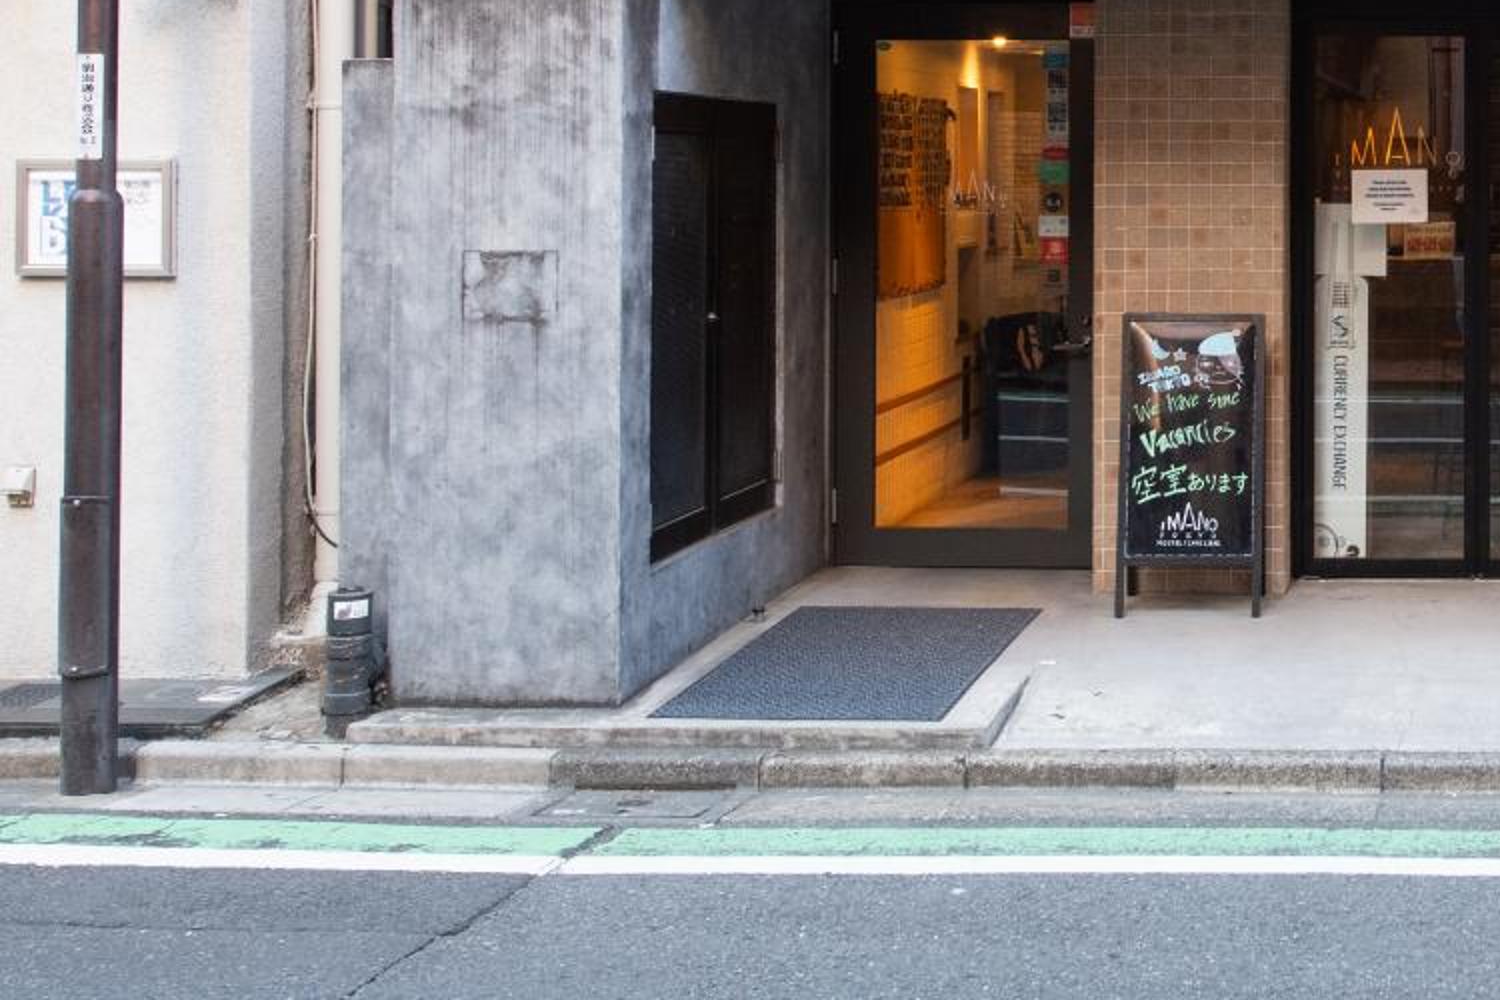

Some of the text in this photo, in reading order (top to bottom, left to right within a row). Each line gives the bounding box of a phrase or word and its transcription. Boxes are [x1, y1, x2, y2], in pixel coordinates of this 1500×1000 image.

[1139, 419, 1236, 458] Vacancies
[1332, 355, 1349, 491] CURRENCY EXCHANGE
[1131, 464, 1249, 504] 空室あります
[1160, 501, 1219, 531] IMANO
